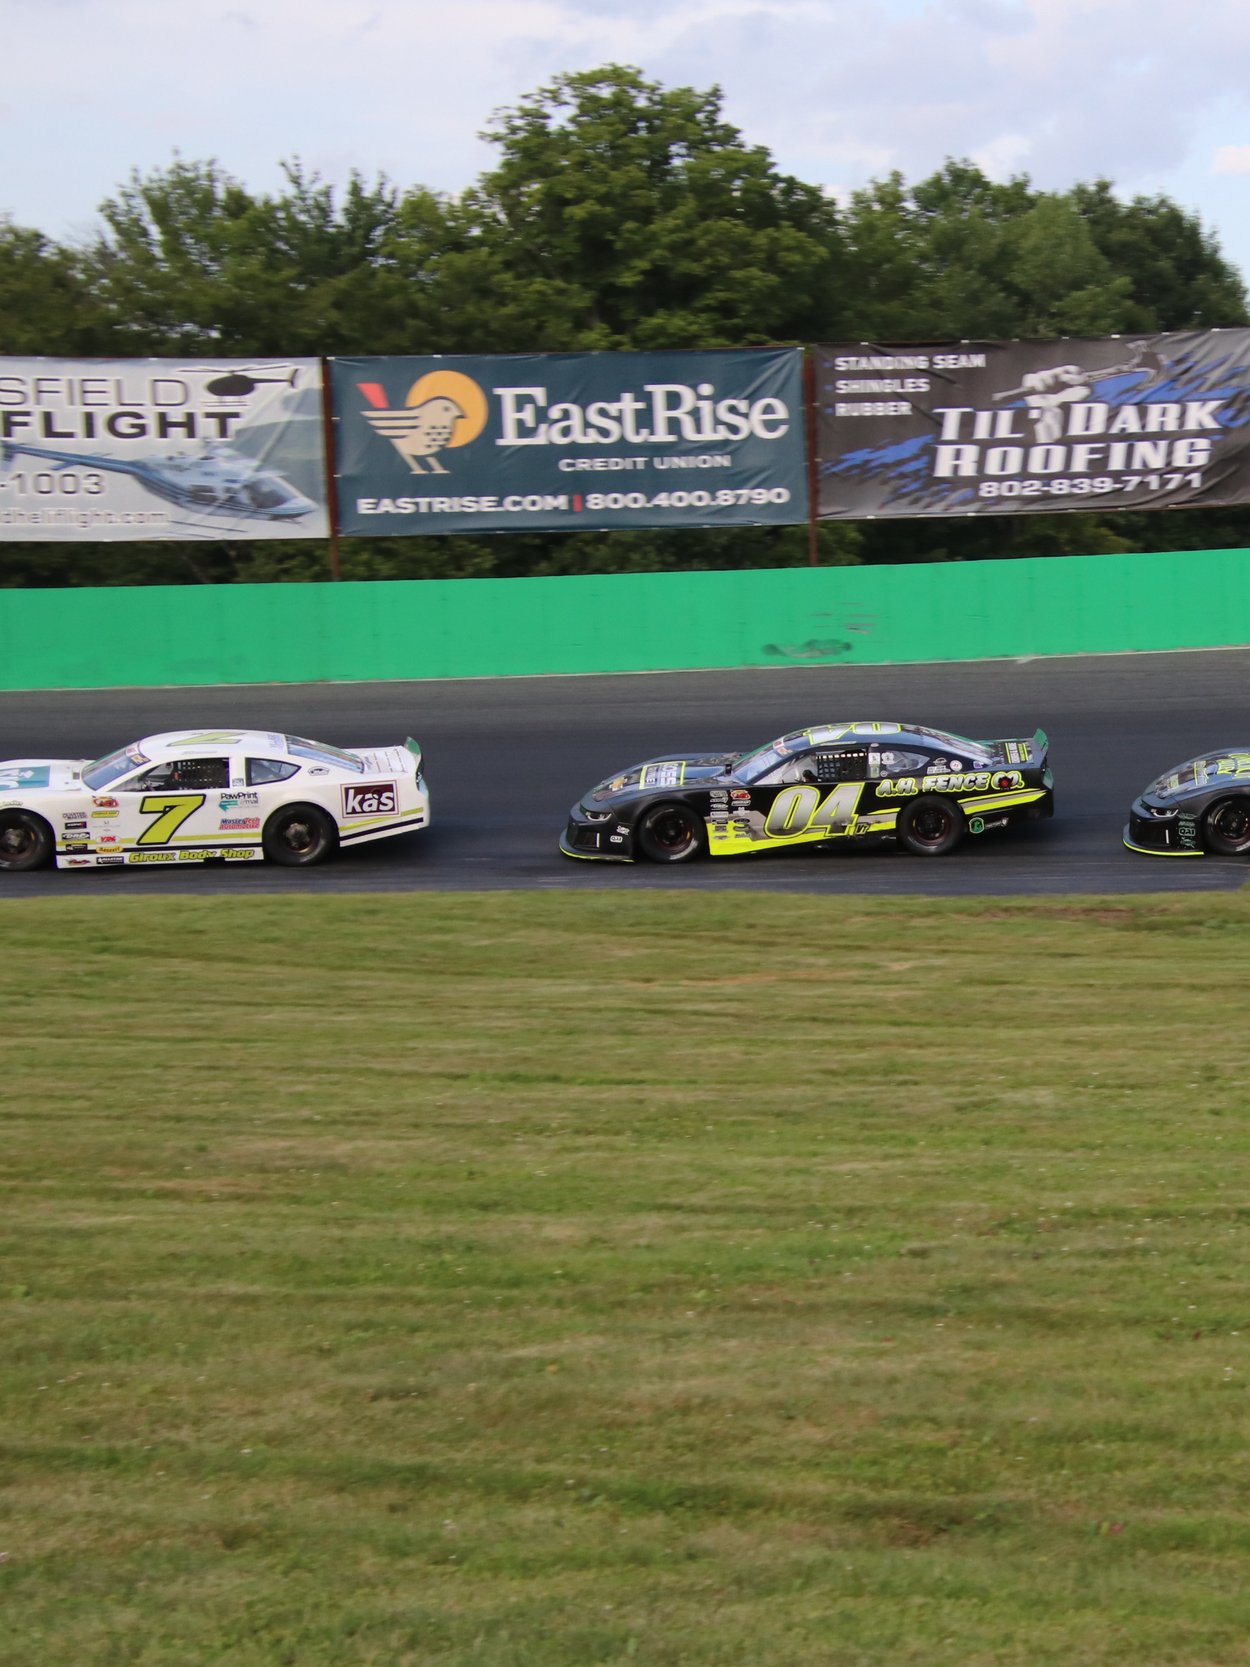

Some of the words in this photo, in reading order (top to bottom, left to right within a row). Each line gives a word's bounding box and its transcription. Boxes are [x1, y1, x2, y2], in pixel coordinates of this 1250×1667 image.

[834, 355, 930, 371] STANDING
[933, 353, 986, 369] SEAM
[835, 378, 930, 394] SHINGLES
[493, 384, 789, 447] EastRise
[834, 402, 912, 417] RUBBER
[1067, 400, 1228, 436] DARK
[1, 410, 242, 439] FLIGHT
[558, 457, 646, 472] CREDIT
[653, 454, 732, 470] UNION
[933, 438, 1212, 477] ROOFING
[978, 472, 1201, 498] 802-839-7171
[357, 495, 568, 515] EASTRISE.COM
[585, 487, 791, 511] 800.400.8790
[876, 778, 918, 797] A.H.
[922, 773, 989, 793] FENCE
[136, 793, 206, 846] 7
[764, 782, 865, 839] 04
[129, 852, 176, 863] Giroux
[220, 848, 255, 859] Shop
